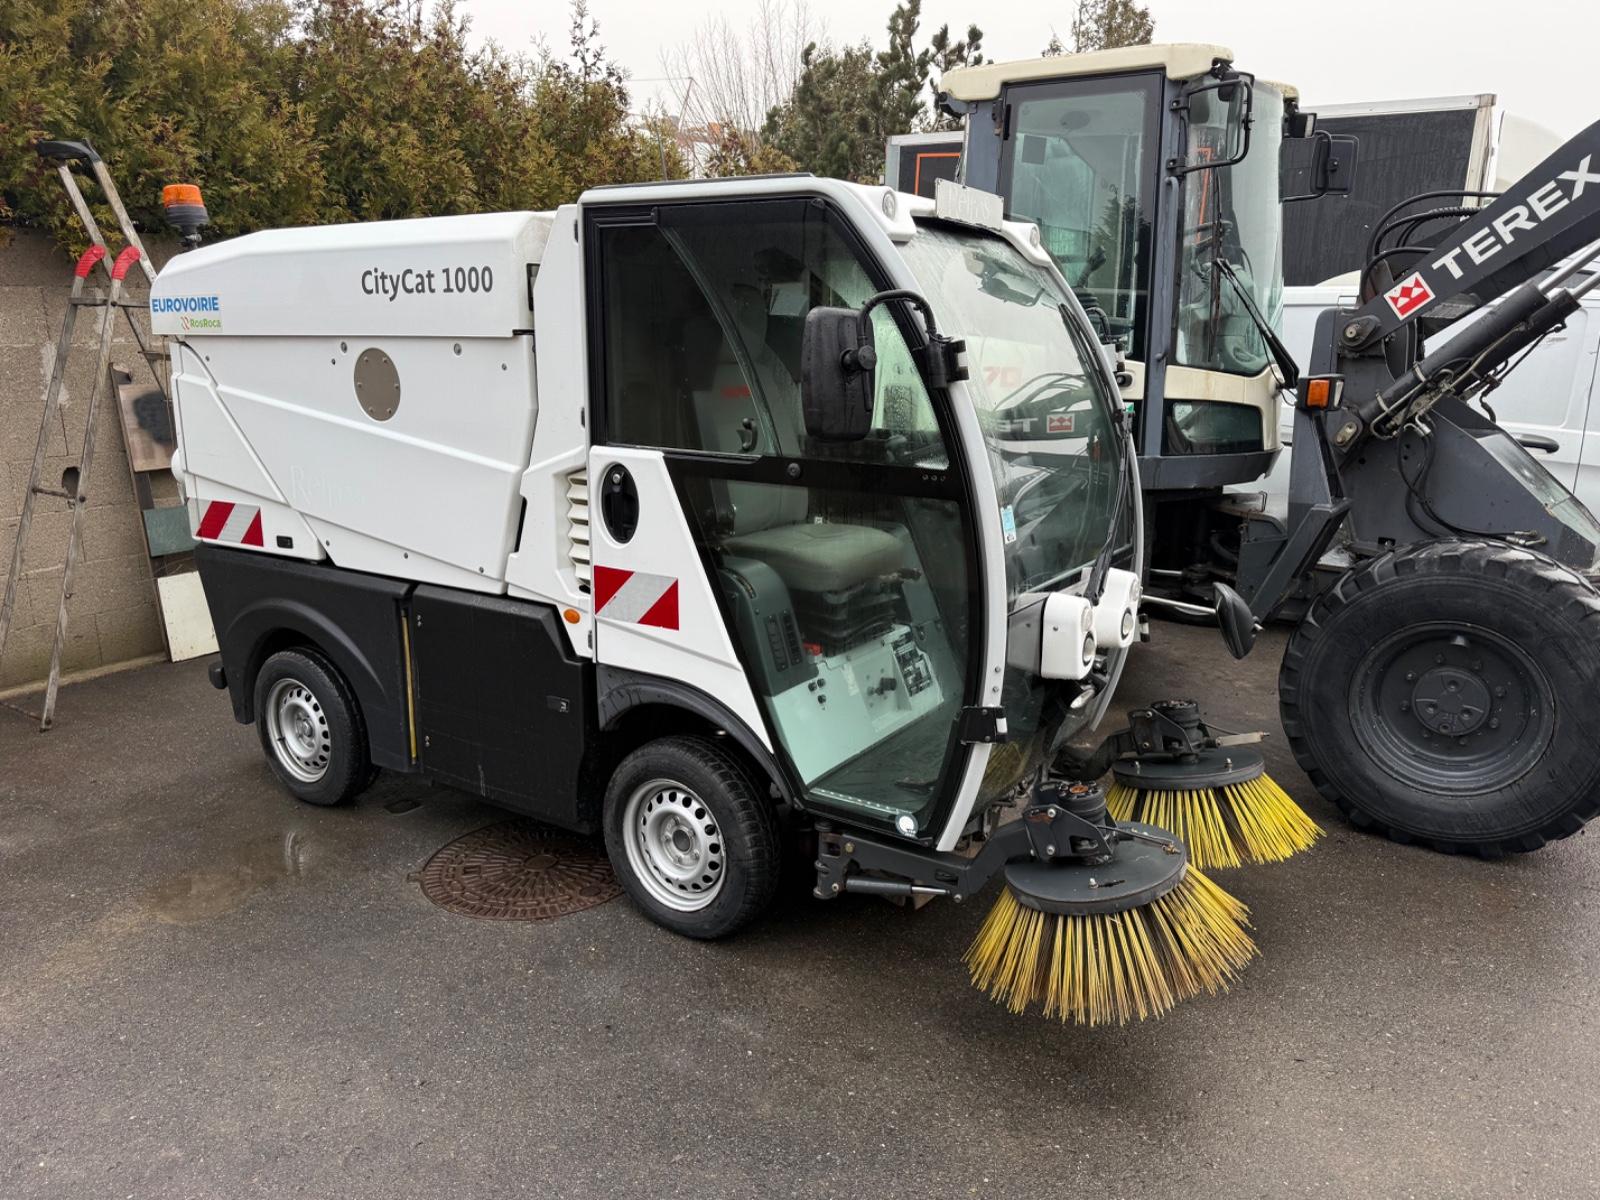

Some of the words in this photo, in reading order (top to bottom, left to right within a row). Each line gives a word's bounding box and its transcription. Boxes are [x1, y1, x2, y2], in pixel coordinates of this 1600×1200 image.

[1431, 153, 1600, 280] TEREX
[361, 267, 436, 302] CityCat
[442, 265, 493, 293] 1000
[151, 297, 219, 313] EUROVOIRIE
